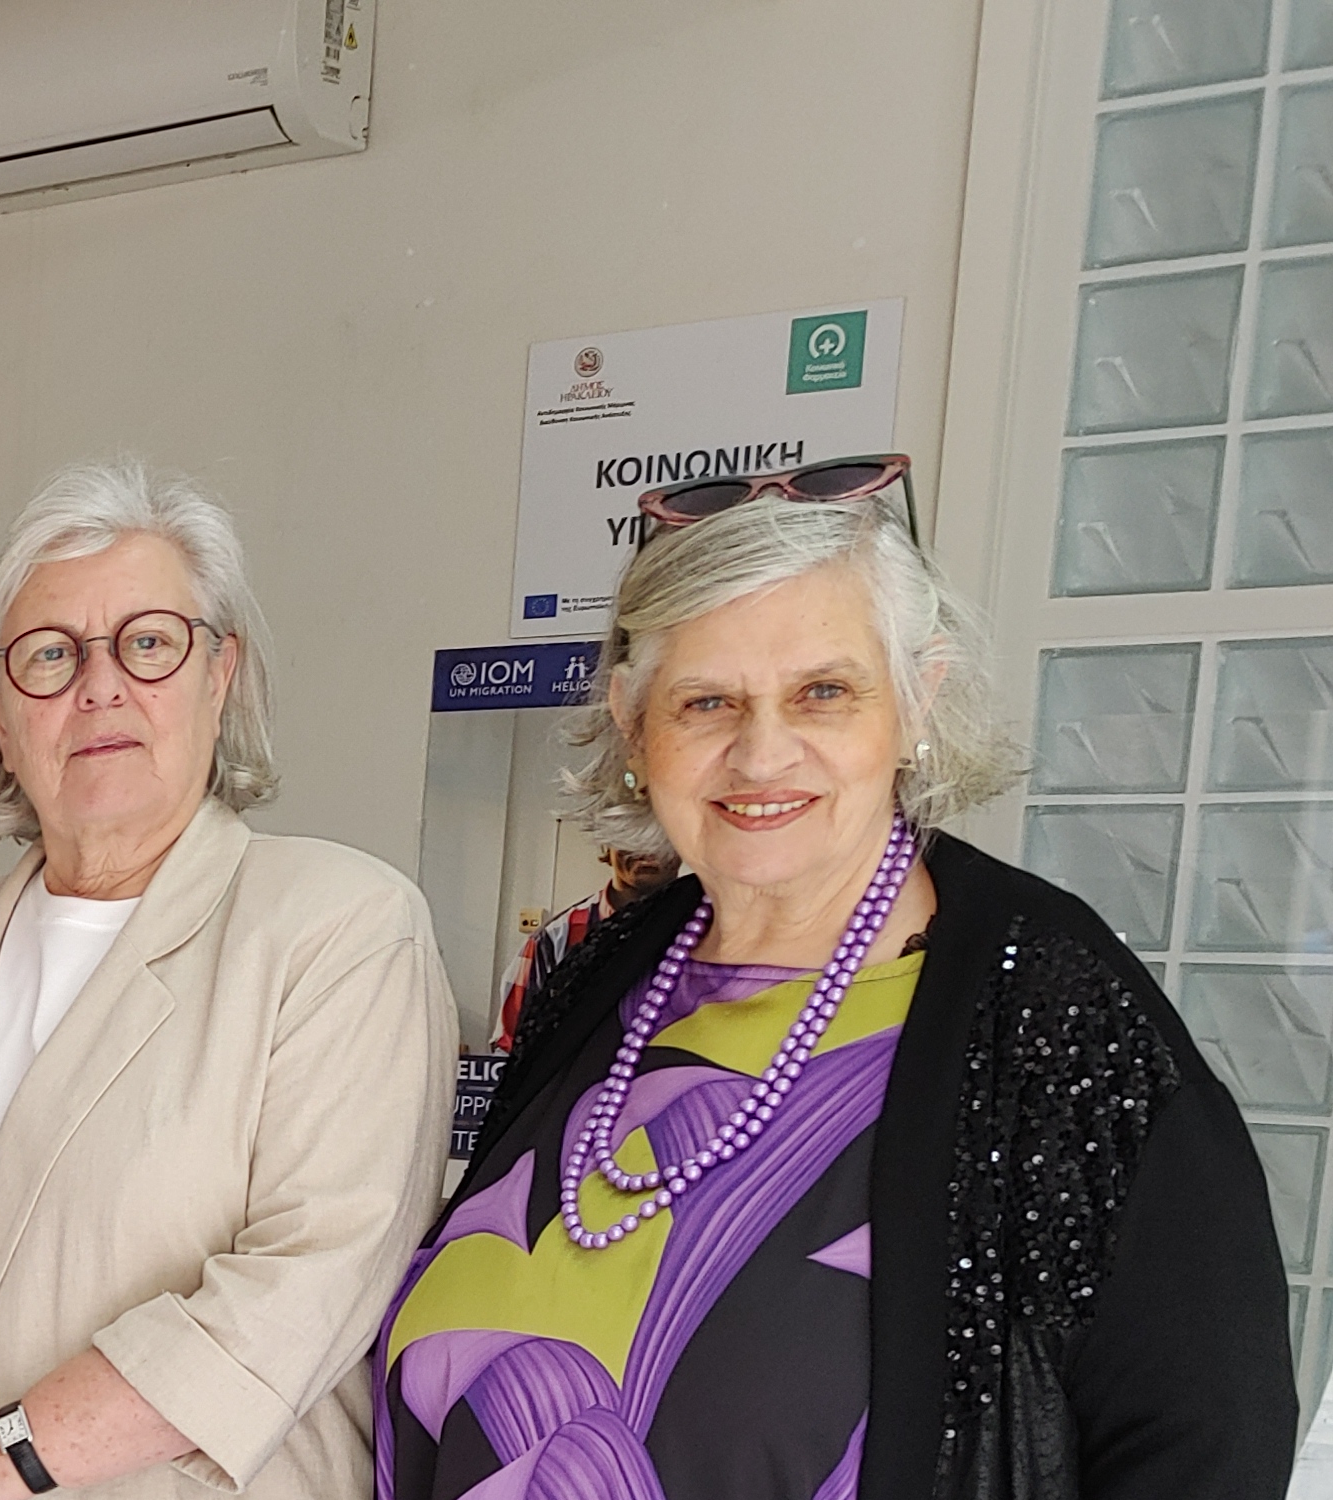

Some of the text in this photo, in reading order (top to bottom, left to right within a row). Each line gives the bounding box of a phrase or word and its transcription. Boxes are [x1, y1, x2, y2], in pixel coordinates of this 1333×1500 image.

[596, 440, 804, 489] ΚΟΙΝΩΝΙΚΗ
[481, 660, 535, 684] IOM
[449, 685, 532, 697] UN MIGRATION
[552, 681, 594, 693] HELIO
